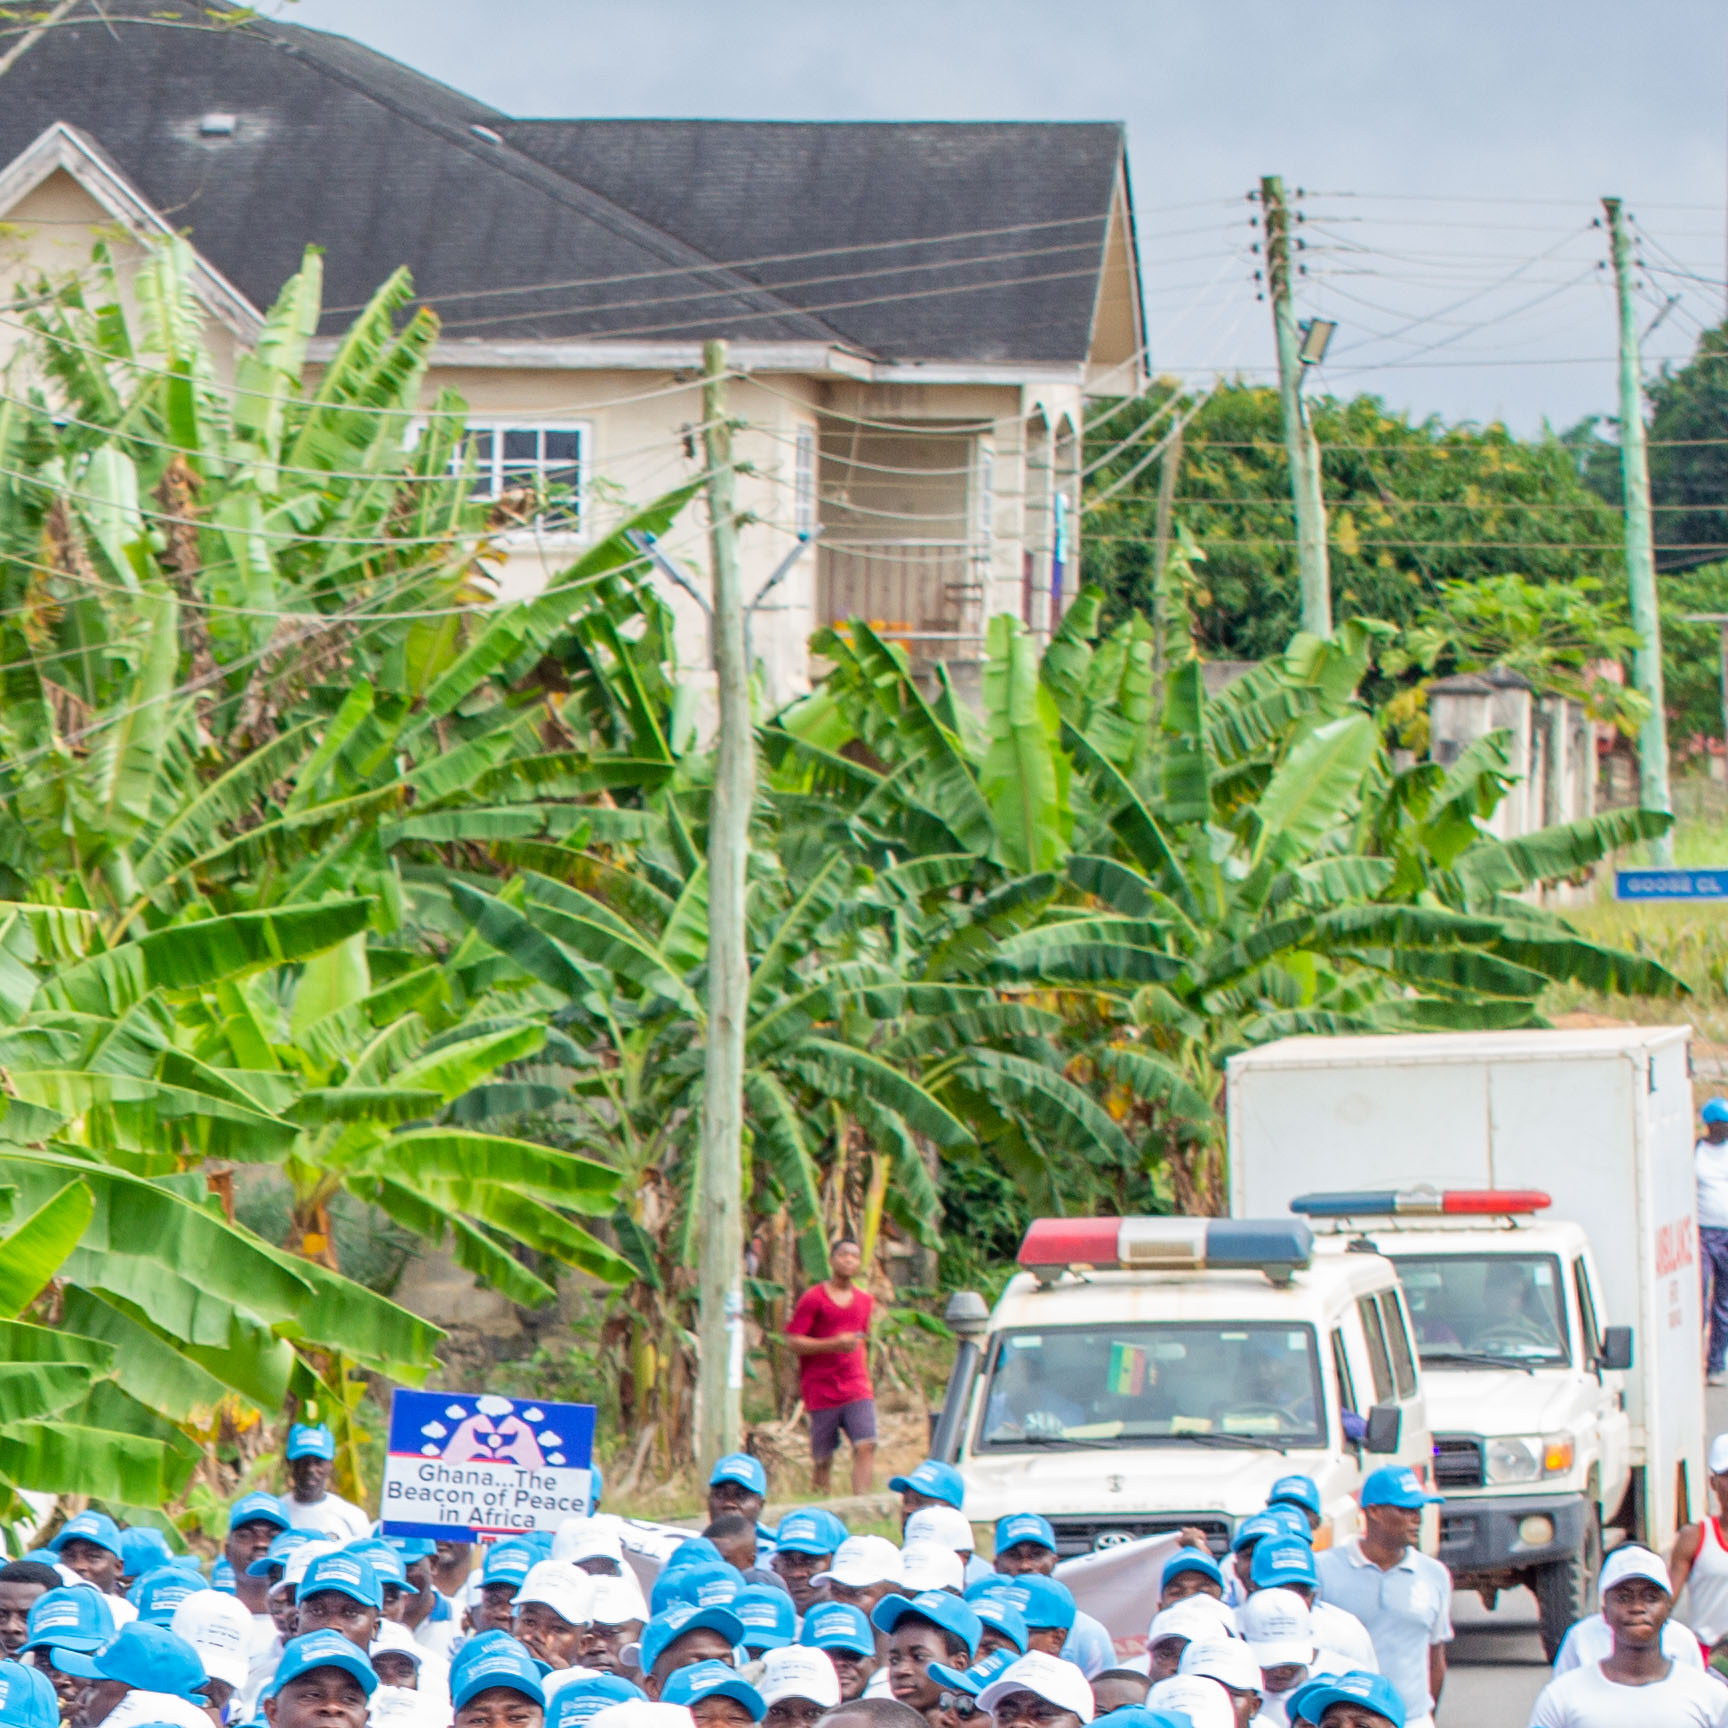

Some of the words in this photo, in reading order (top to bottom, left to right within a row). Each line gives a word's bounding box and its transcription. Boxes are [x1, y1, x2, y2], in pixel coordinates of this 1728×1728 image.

[387, 1481, 475, 1506] Beacon
[483, 1488, 510, 1507] of
[514, 1490, 585, 1513] Peace
[439, 1504, 460, 1523] in
[467, 1507, 537, 1530] Africa
